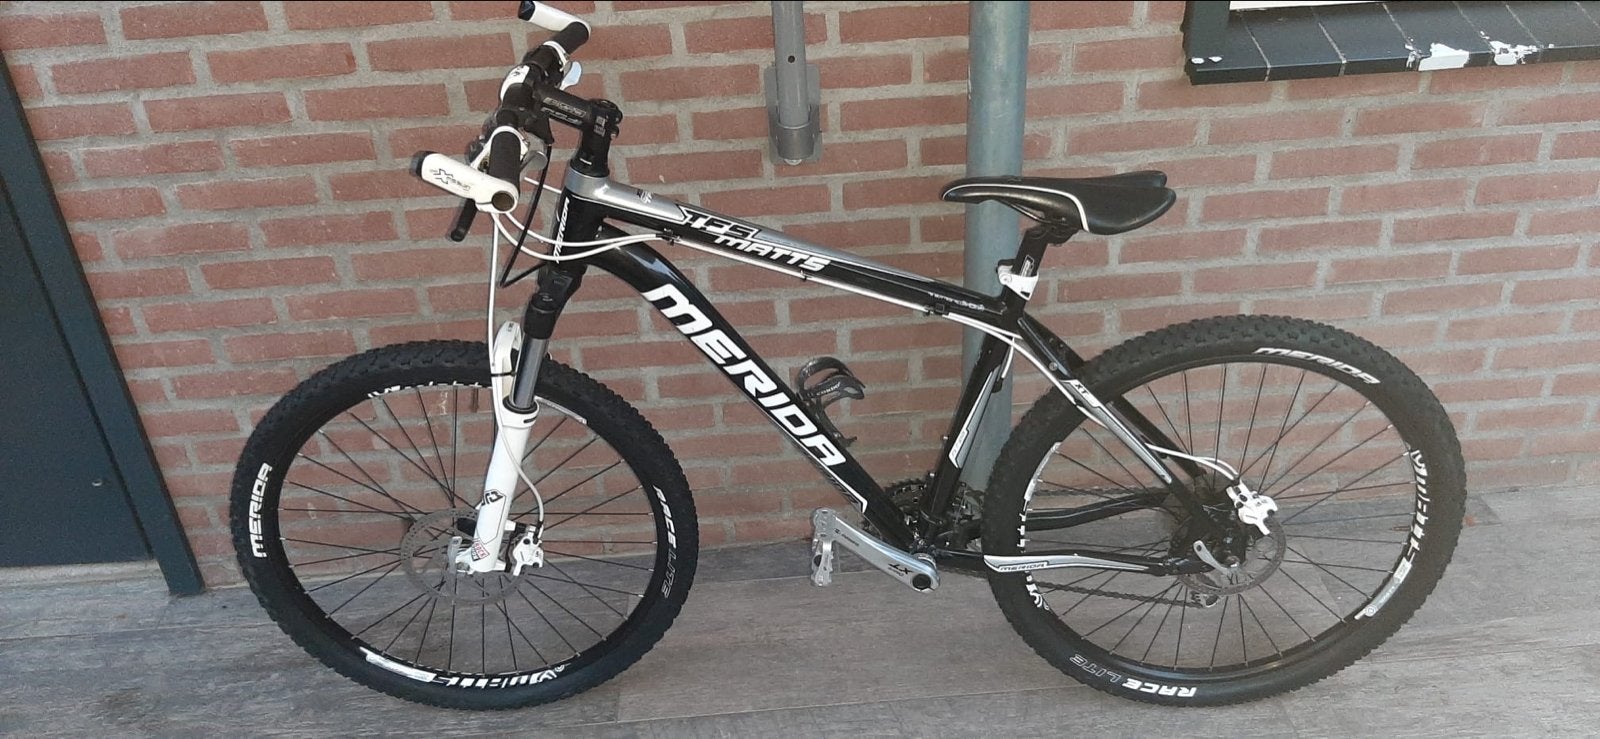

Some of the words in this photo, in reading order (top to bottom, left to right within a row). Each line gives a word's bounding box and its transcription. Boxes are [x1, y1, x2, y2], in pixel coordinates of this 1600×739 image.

[553, 197, 570, 264] MERIDA
[714, 235, 831, 271] MATTS
[642, 283, 847, 466] MERIDA
[1253, 347, 1381, 384] MERIDA
[249, 462, 272, 558] MERIDA
[652, 484, 677, 549] RACE
[661, 548, 677, 598] LITE
[1000, 563, 1046, 571] MERIDA
[1069, 653, 1122, 683] LITE
[1121, 678, 1197, 697] RACE
